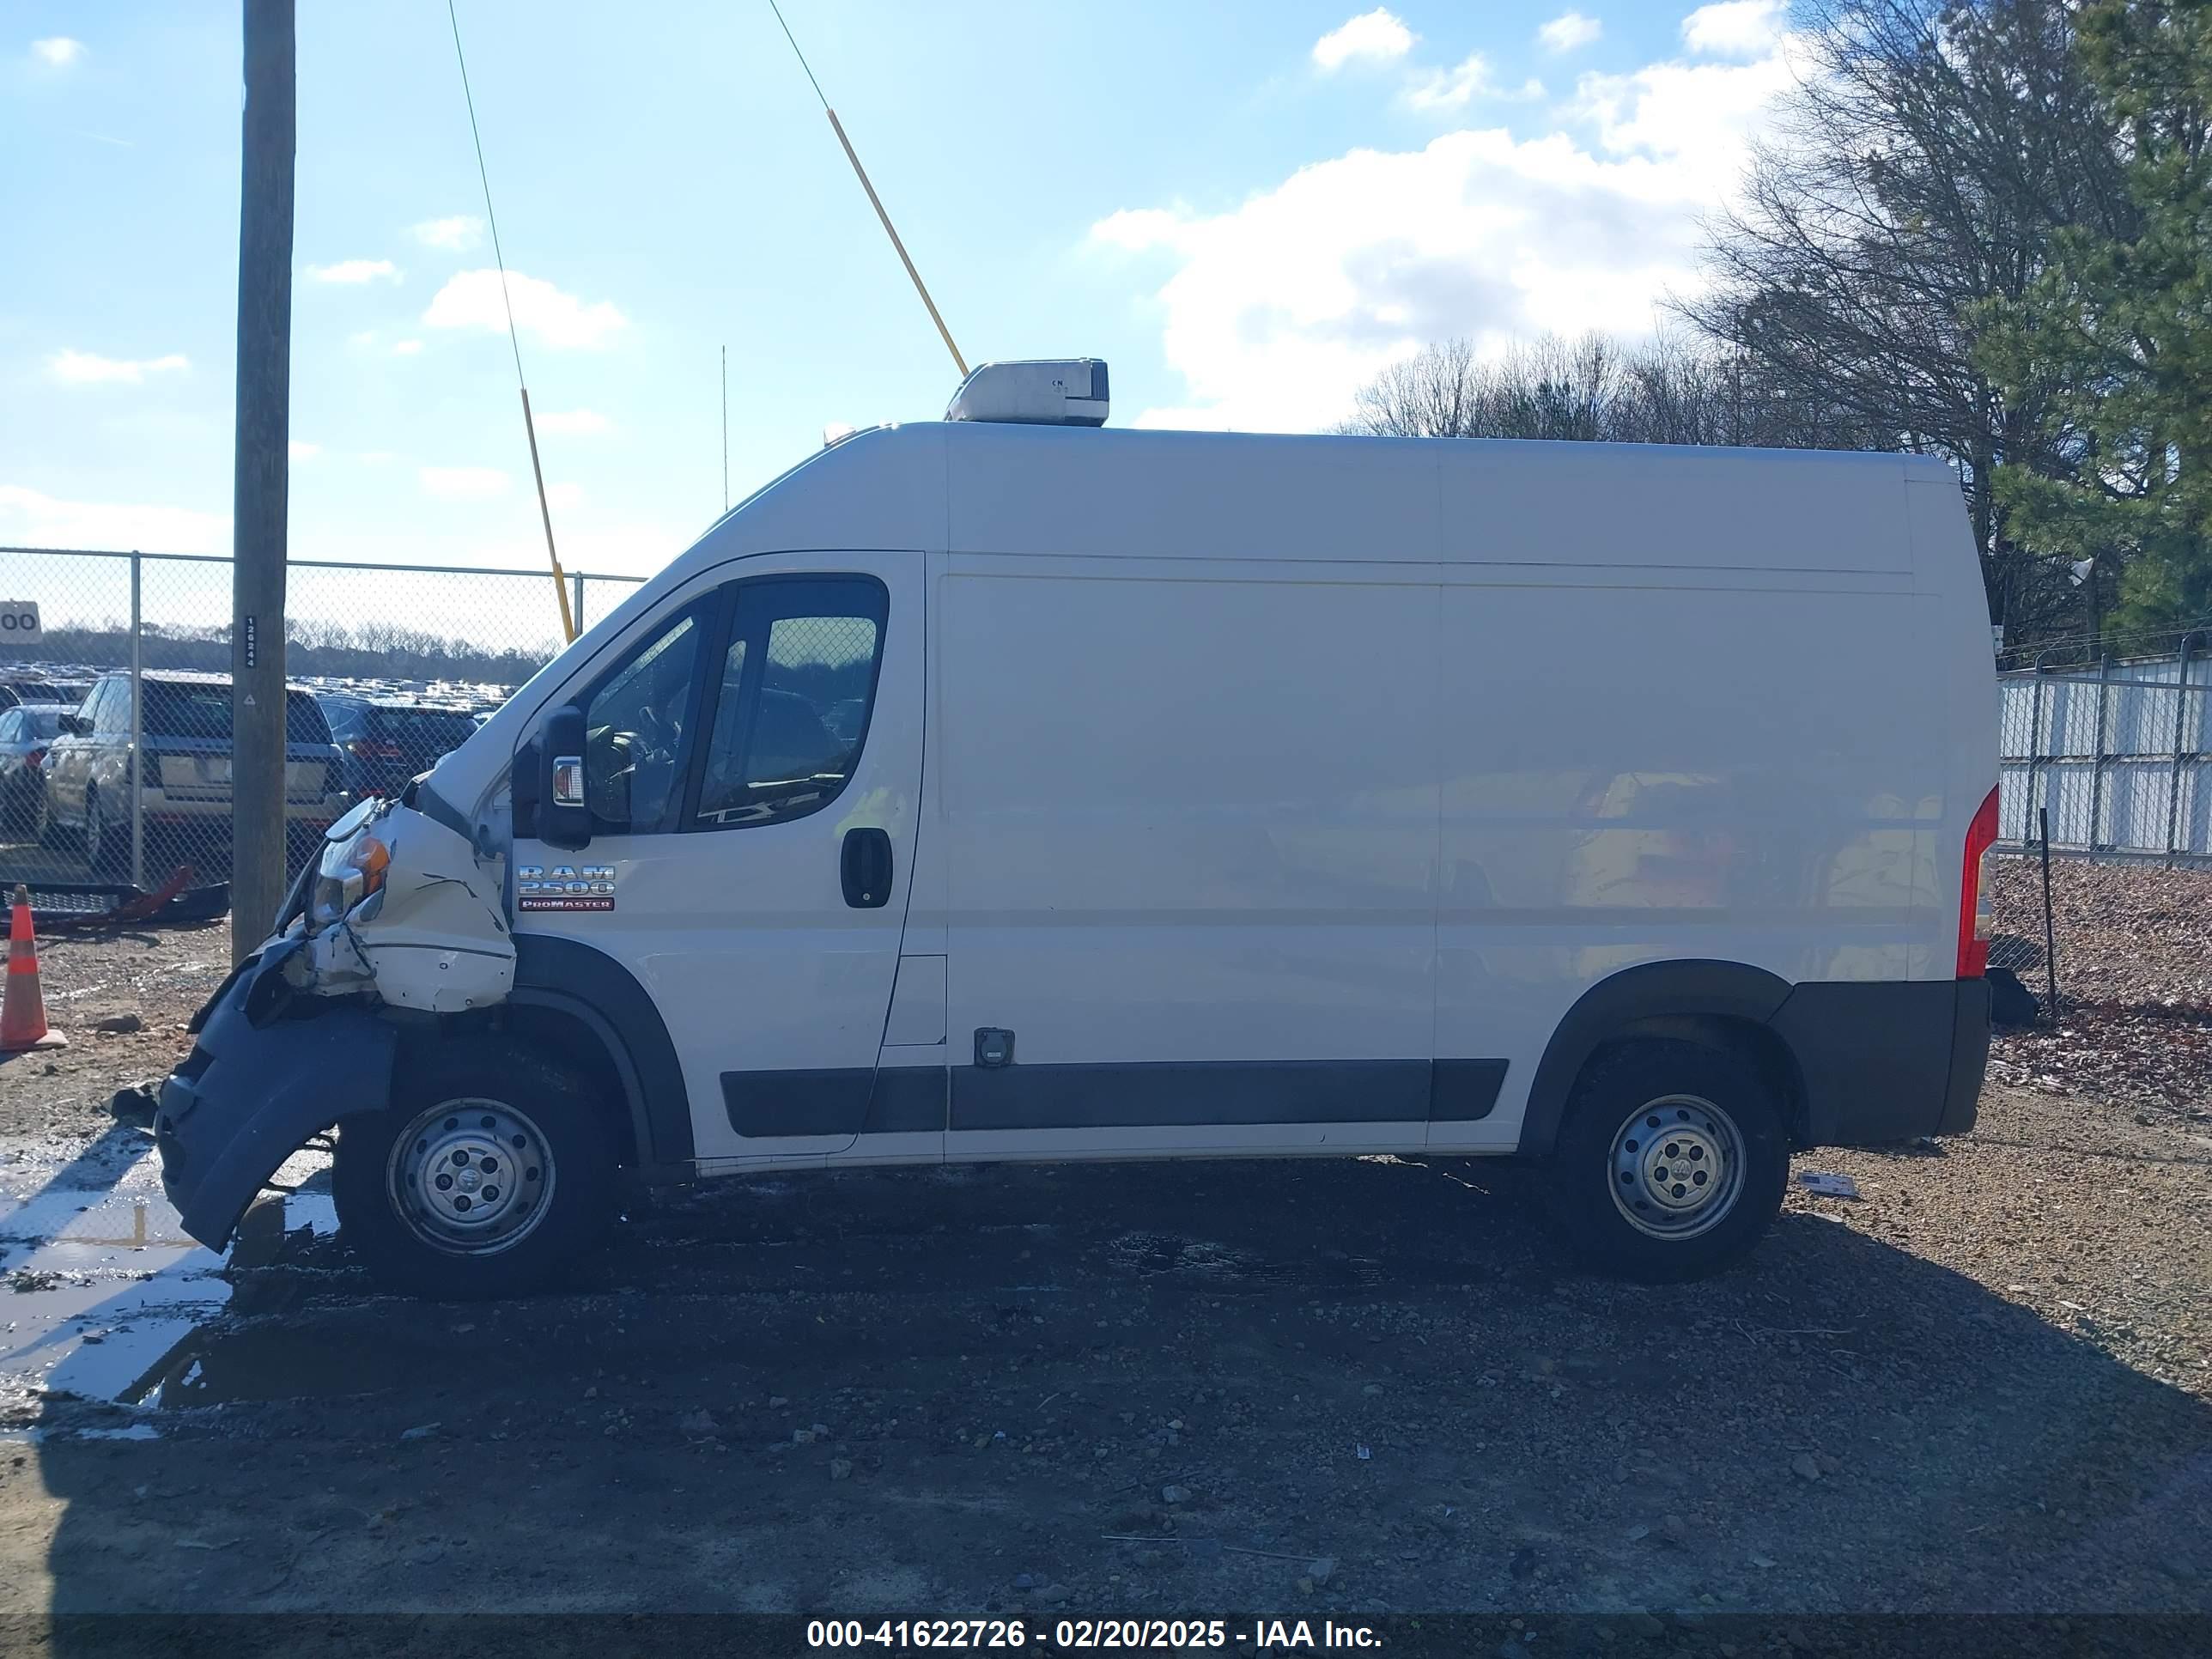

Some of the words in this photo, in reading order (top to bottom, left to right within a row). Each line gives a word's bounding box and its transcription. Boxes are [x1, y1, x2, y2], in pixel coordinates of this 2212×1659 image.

[246, 617, 255, 667] 126244
[518, 865, 616, 880] RAM
[518, 880, 616, 896] 2500
